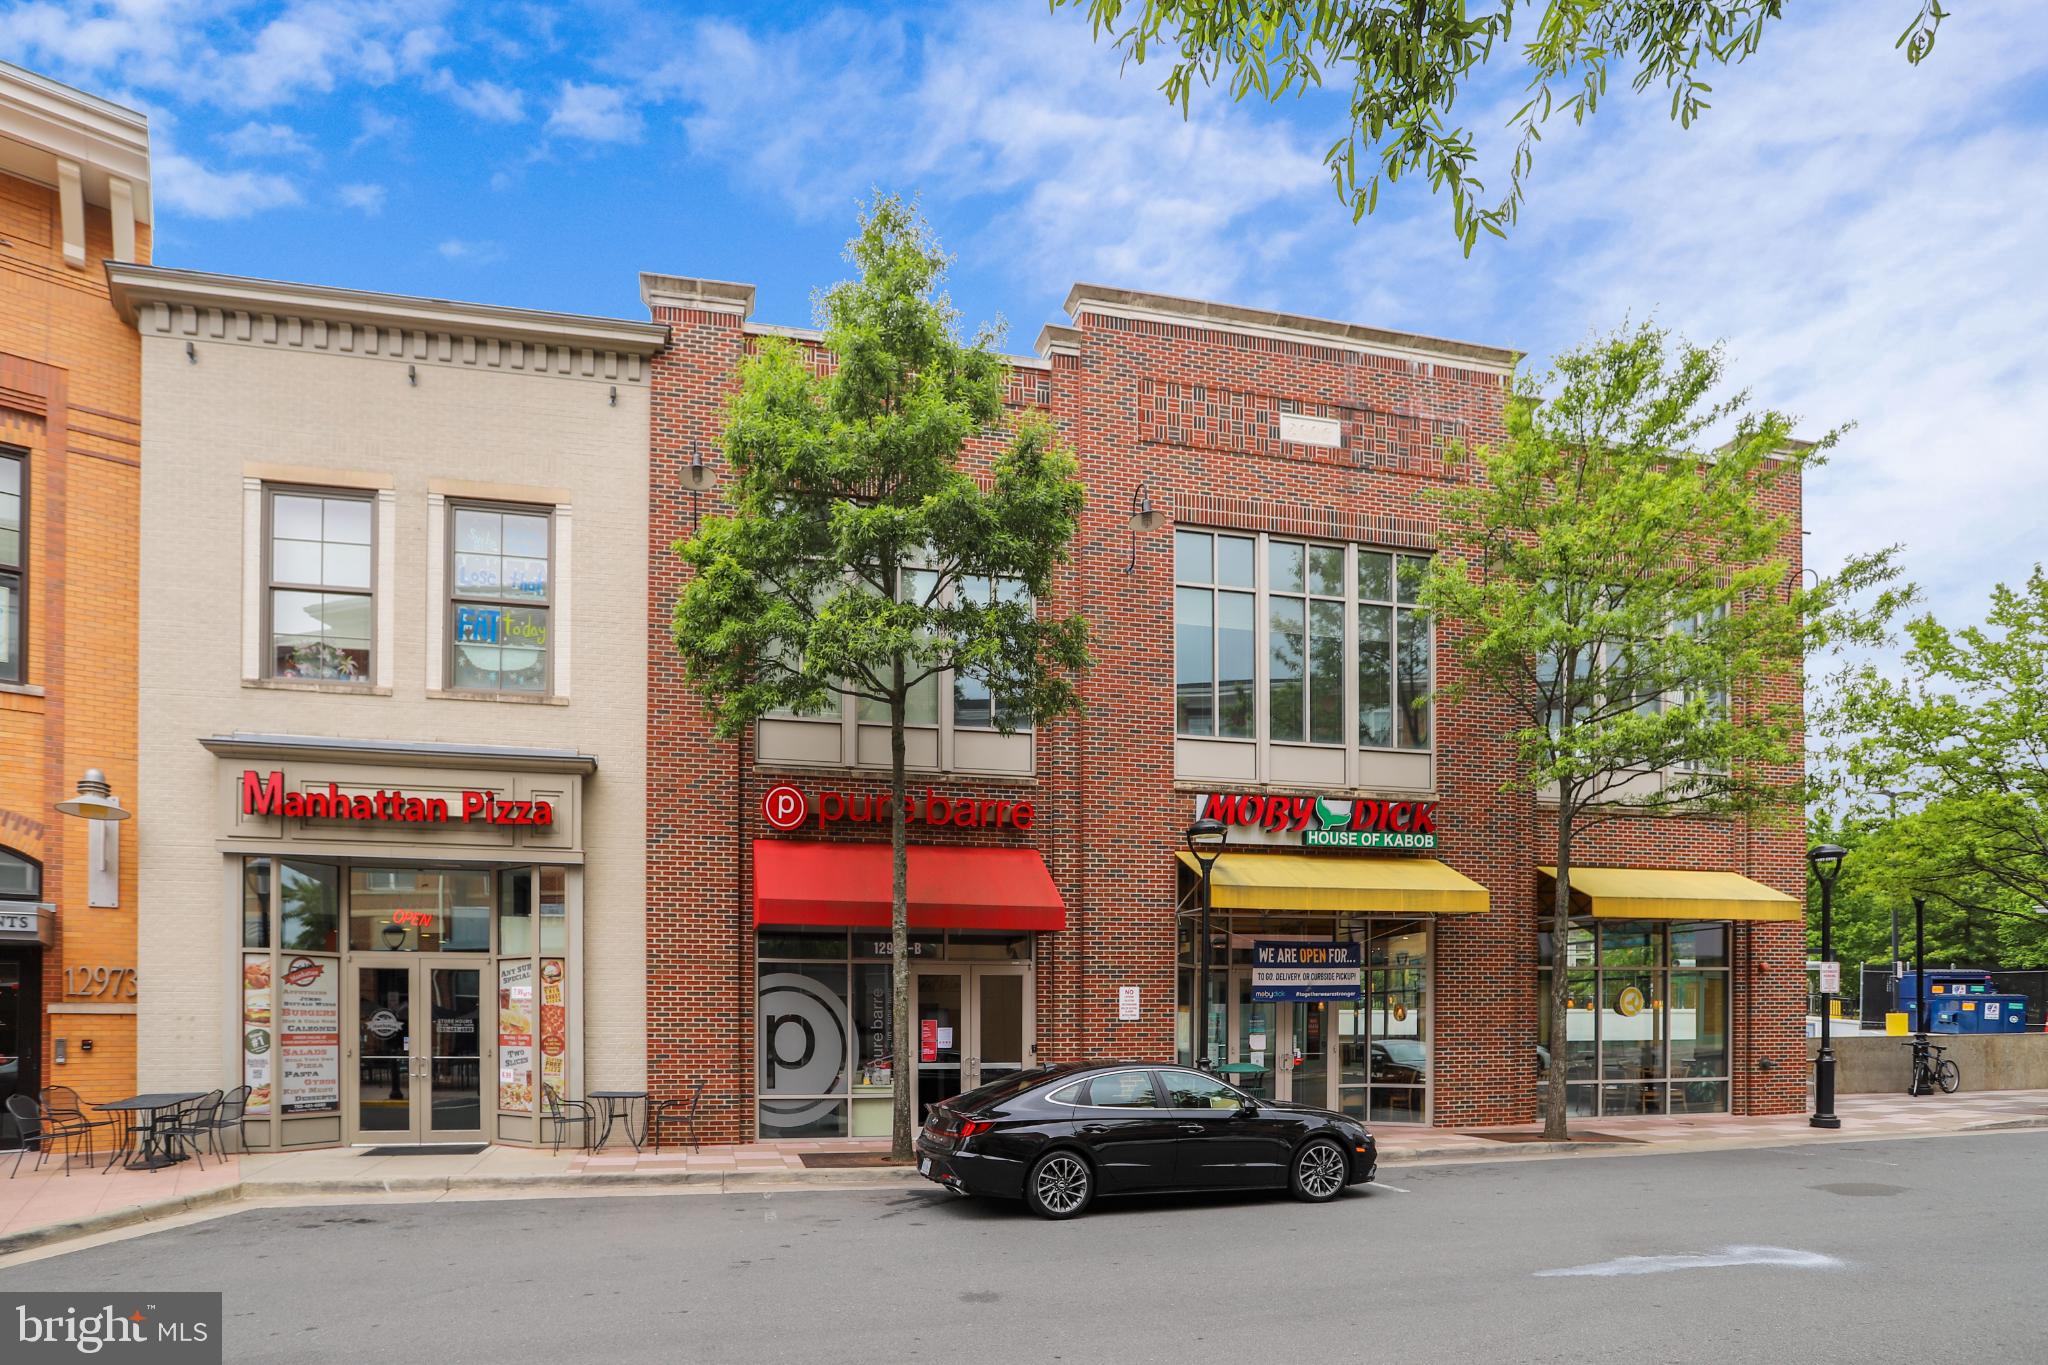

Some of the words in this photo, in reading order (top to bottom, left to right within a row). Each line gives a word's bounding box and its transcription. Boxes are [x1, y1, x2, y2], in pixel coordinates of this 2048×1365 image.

[503, 610, 547, 645] today
[243, 770, 449, 823] Manhattan
[461, 790, 554, 826] Pizza
[926, 786, 1035, 829] barre
[1204, 793, 1317, 833] MOBY
[1350, 799, 1439, 834] DICK
[1308, 830, 1358, 847] HOUSE
[1361, 832, 1380, 847] OF
[1384, 834, 1435, 848] KABOB
[392, 908, 433, 927] OPEN
[1259, 947, 1275, 963] WE
[1277, 947, 1298, 963] ARE
[1299, 947, 1327, 963] OPEN
[1328, 948, 1356, 963] FOR...
[65, 966, 138, 997] 12973
[1258, 972, 1264, 981] TO
[1302, 972, 1310, 981] OR
[1310, 972, 1335, 981] CURBSIDE
[281, 1008, 337, 1016] BURGERS
[870, 988, 884, 1030] barre
